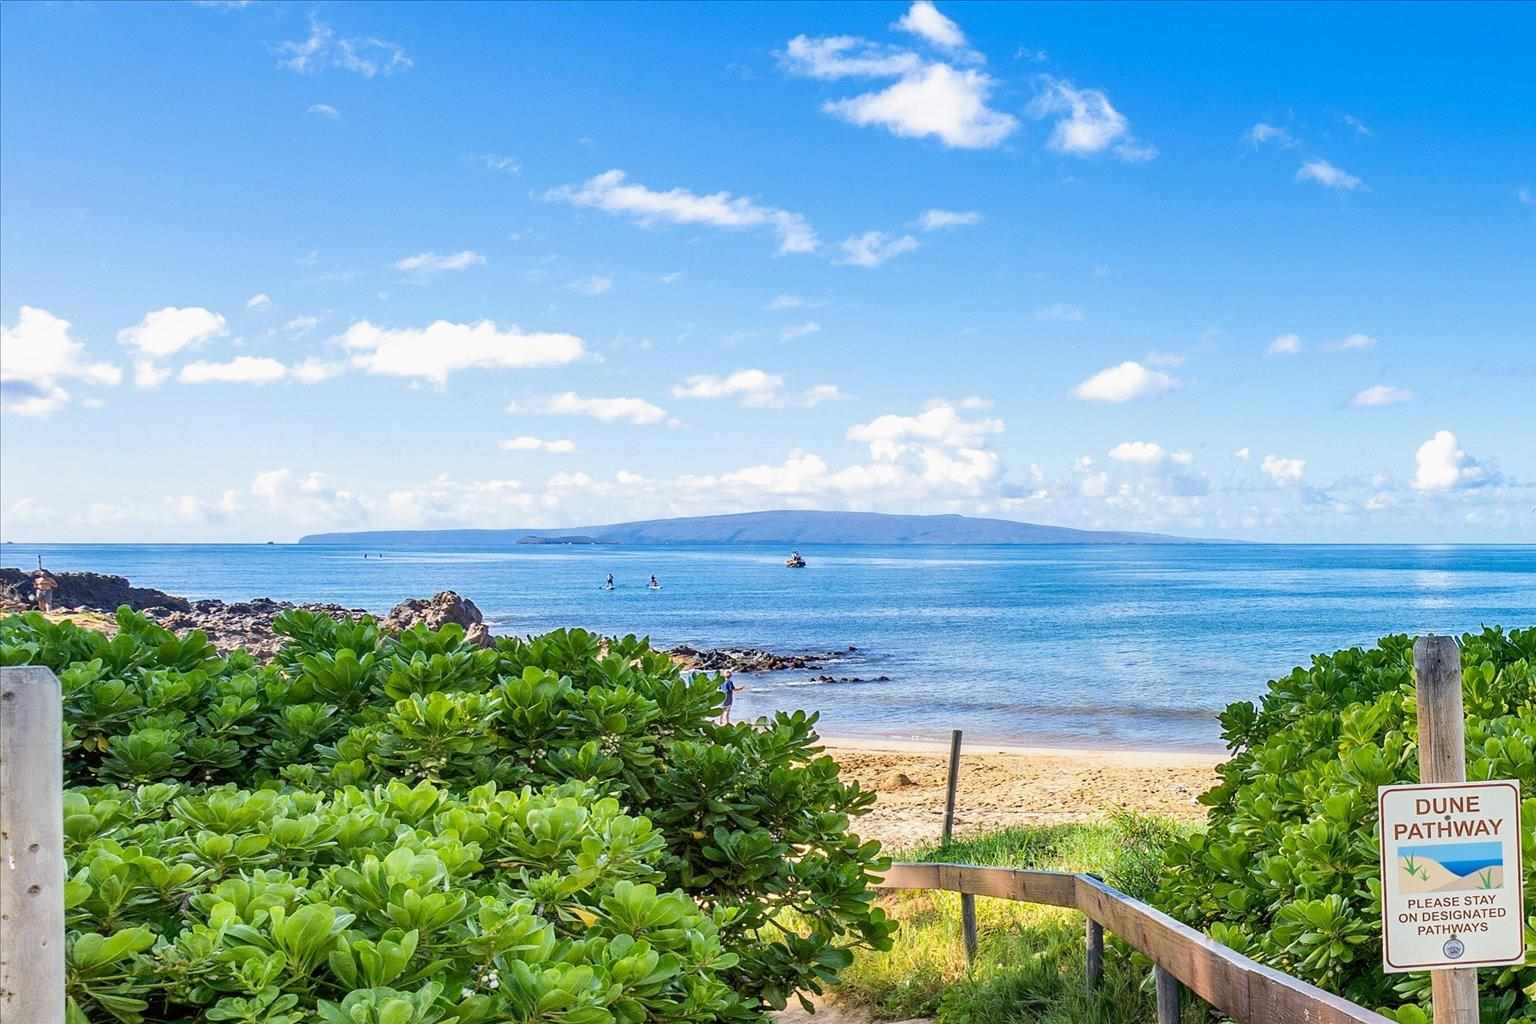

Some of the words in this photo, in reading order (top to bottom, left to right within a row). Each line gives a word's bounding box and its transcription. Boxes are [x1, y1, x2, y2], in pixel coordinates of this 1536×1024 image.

[1416, 796, 1480, 815] DUNE
[1394, 819, 1503, 840] PATHWAY
[1408, 897, 1460, 909] PLEASE
[1464, 895, 1496, 906] STAY
[1399, 912, 1418, 924] ON
[1422, 908, 1506, 922] DESIGNATED
[1418, 922, 1488, 936] PATHWAYS
